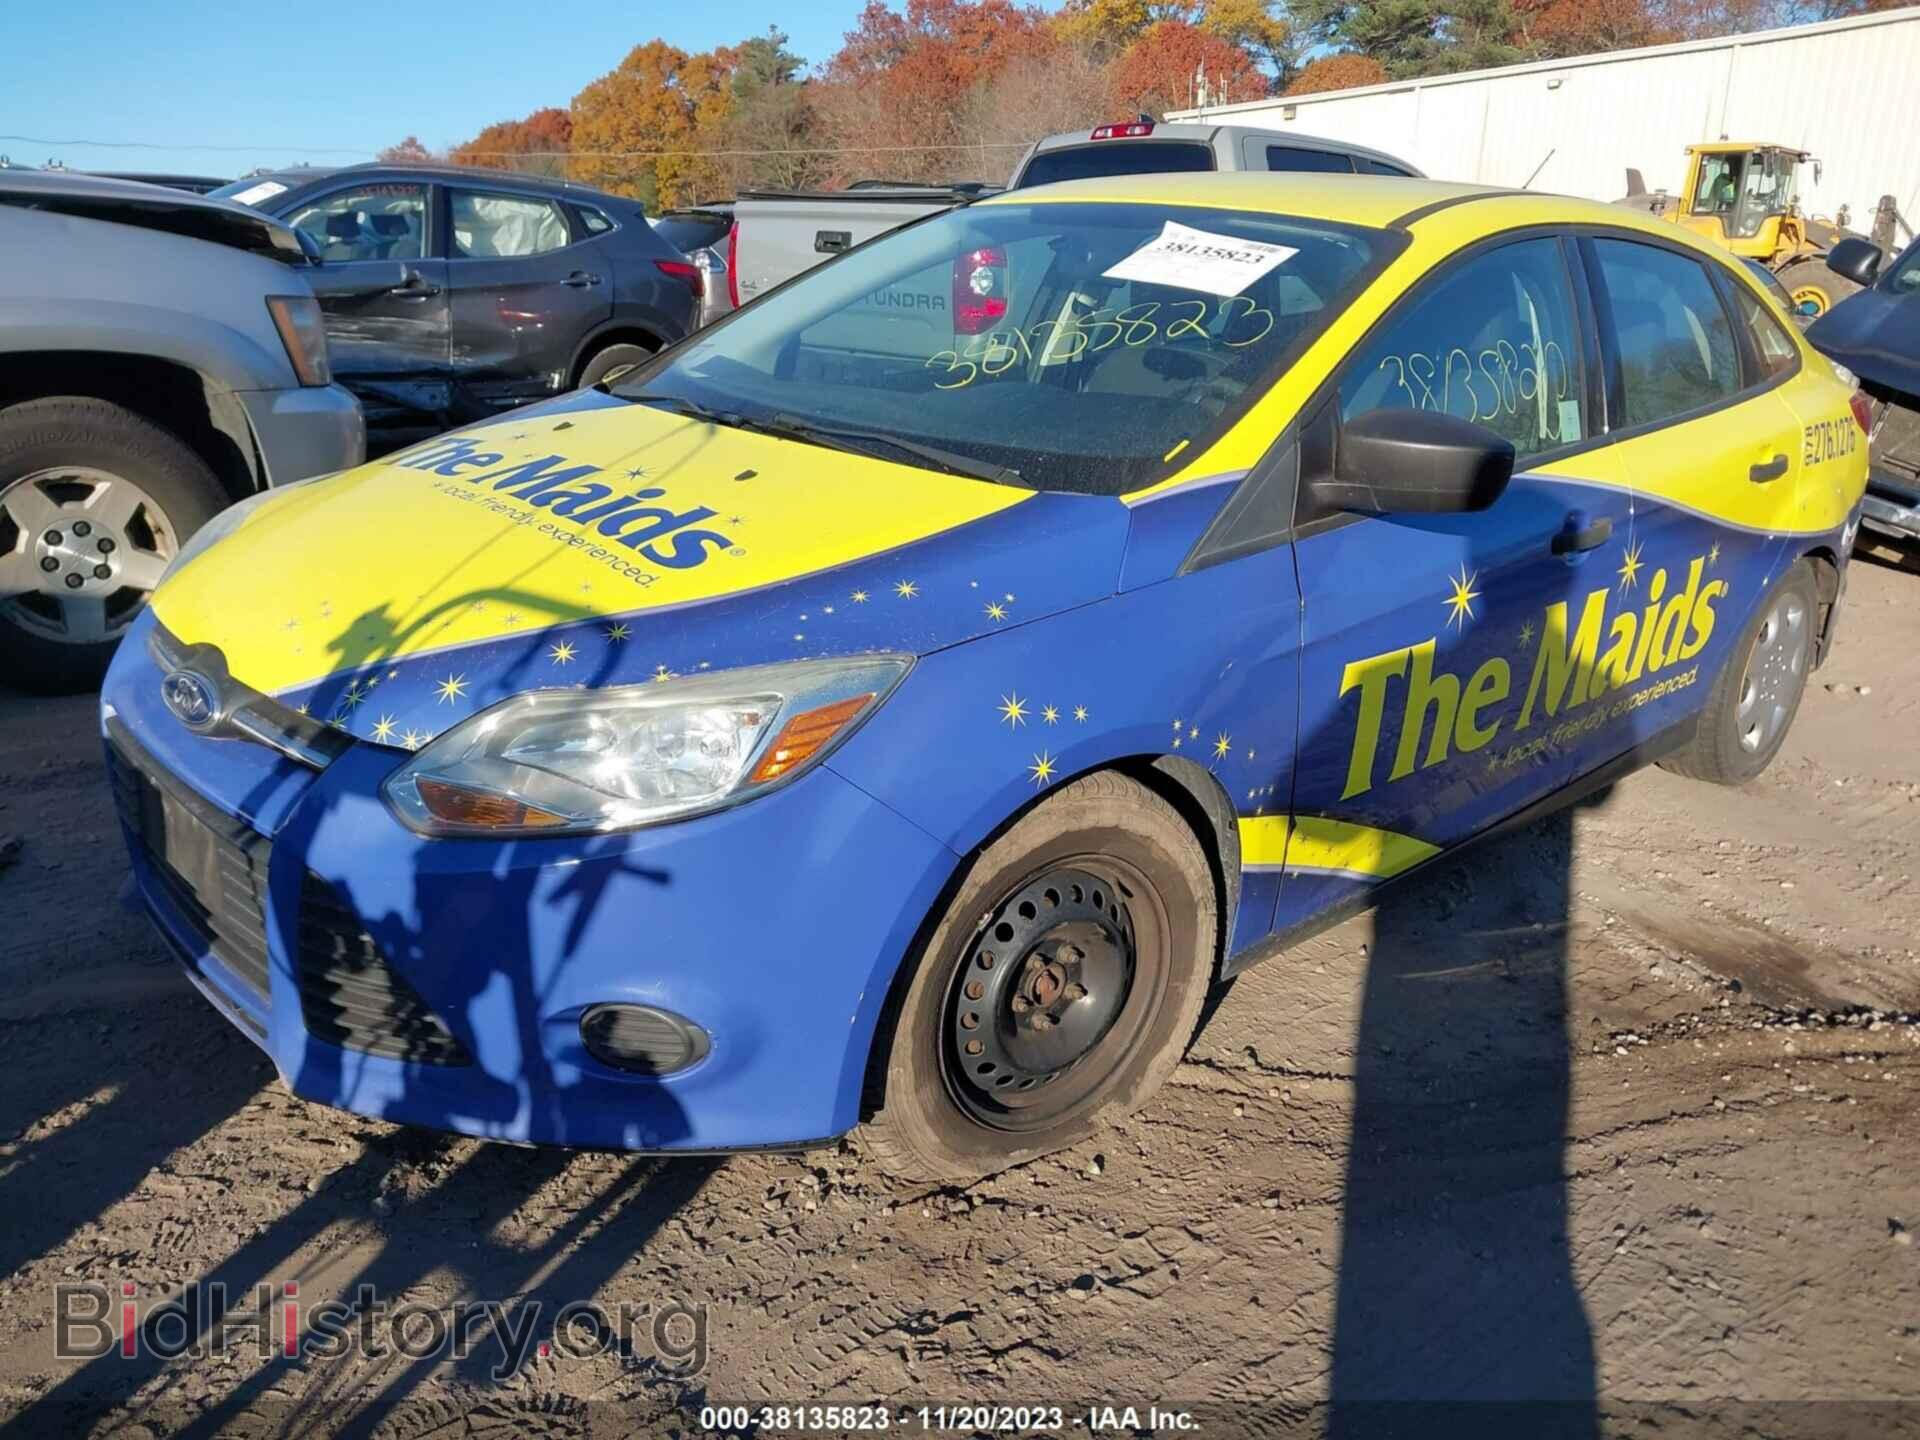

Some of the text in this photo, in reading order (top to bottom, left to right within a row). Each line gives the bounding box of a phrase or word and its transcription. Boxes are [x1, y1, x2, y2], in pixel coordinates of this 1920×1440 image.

[925, 296, 1275, 390] 38135823
[384, 437, 735, 570] The Maids
[1338, 554, 1725, 802] The Maids
